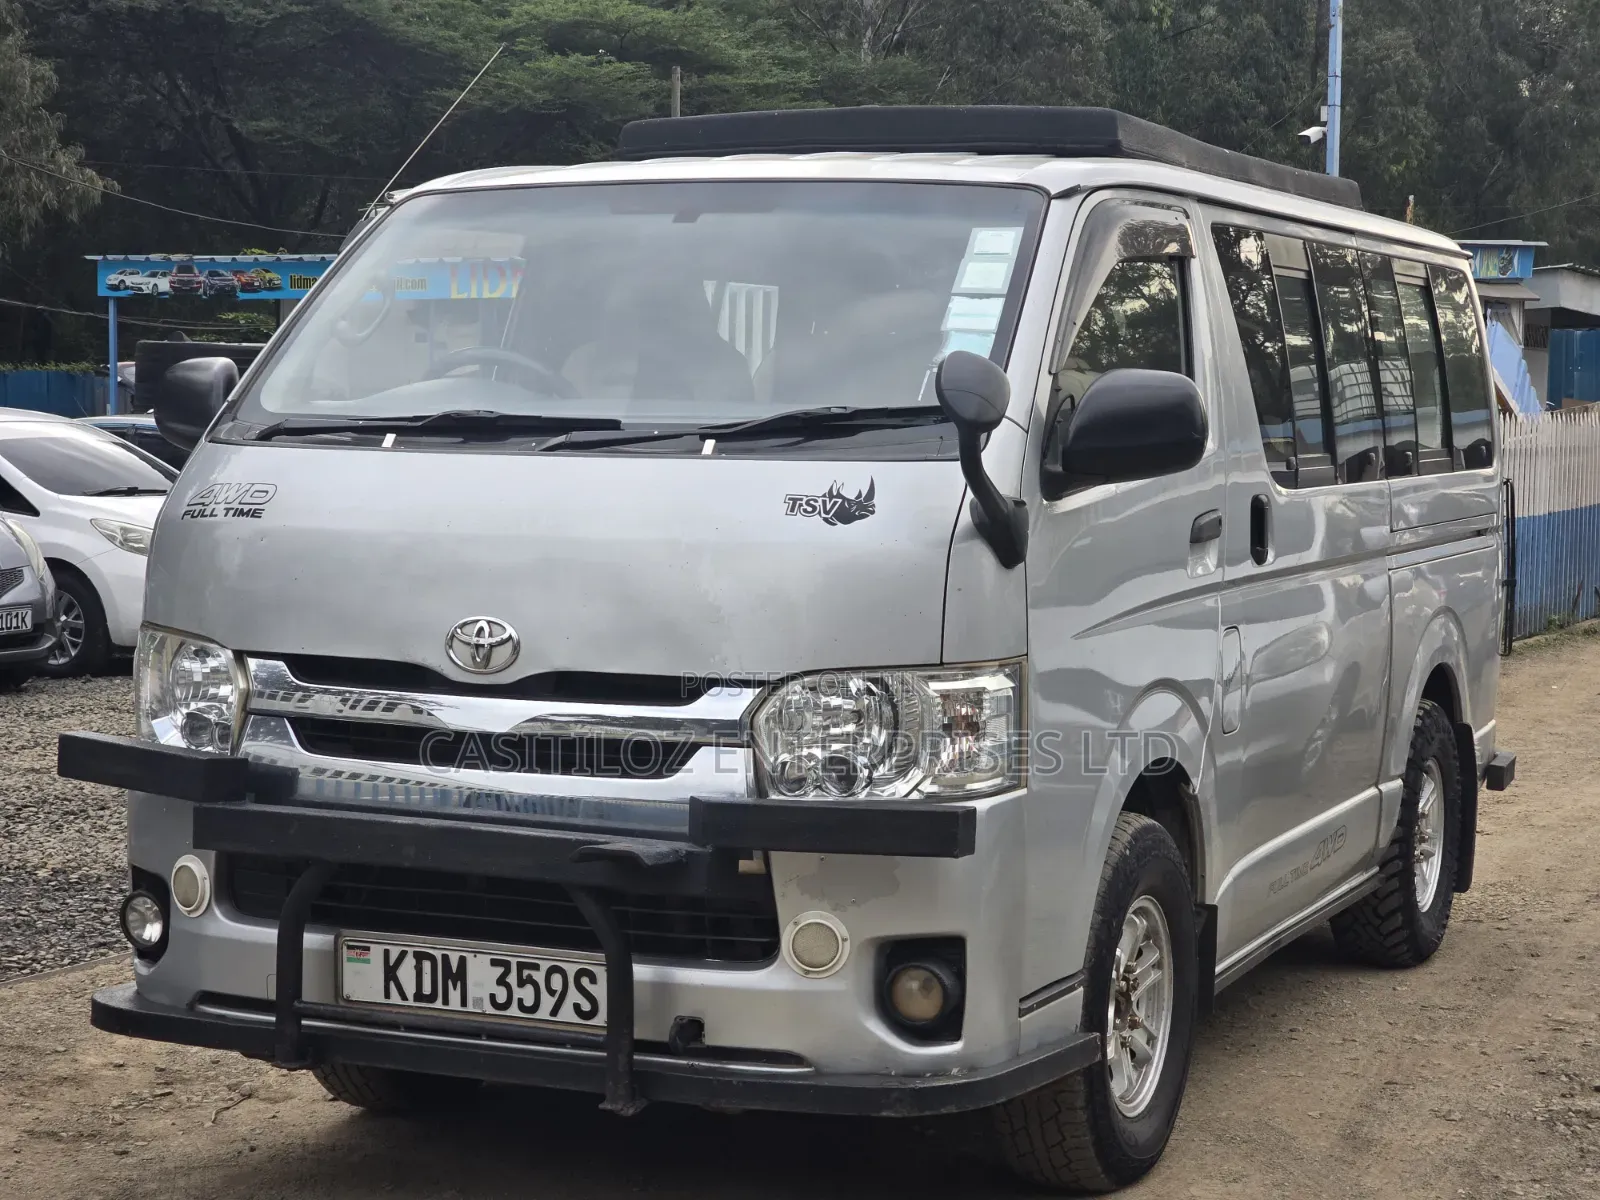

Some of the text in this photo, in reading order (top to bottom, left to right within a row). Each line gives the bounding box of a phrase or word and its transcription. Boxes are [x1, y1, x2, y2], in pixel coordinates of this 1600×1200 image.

[289, 273, 319, 290] lidma
[187, 483, 277, 506] 4WD
[784, 494, 842, 518] TSV
[181, 507, 265, 520] FULL TIME
[383, 948, 599, 1021] KDM 359S
